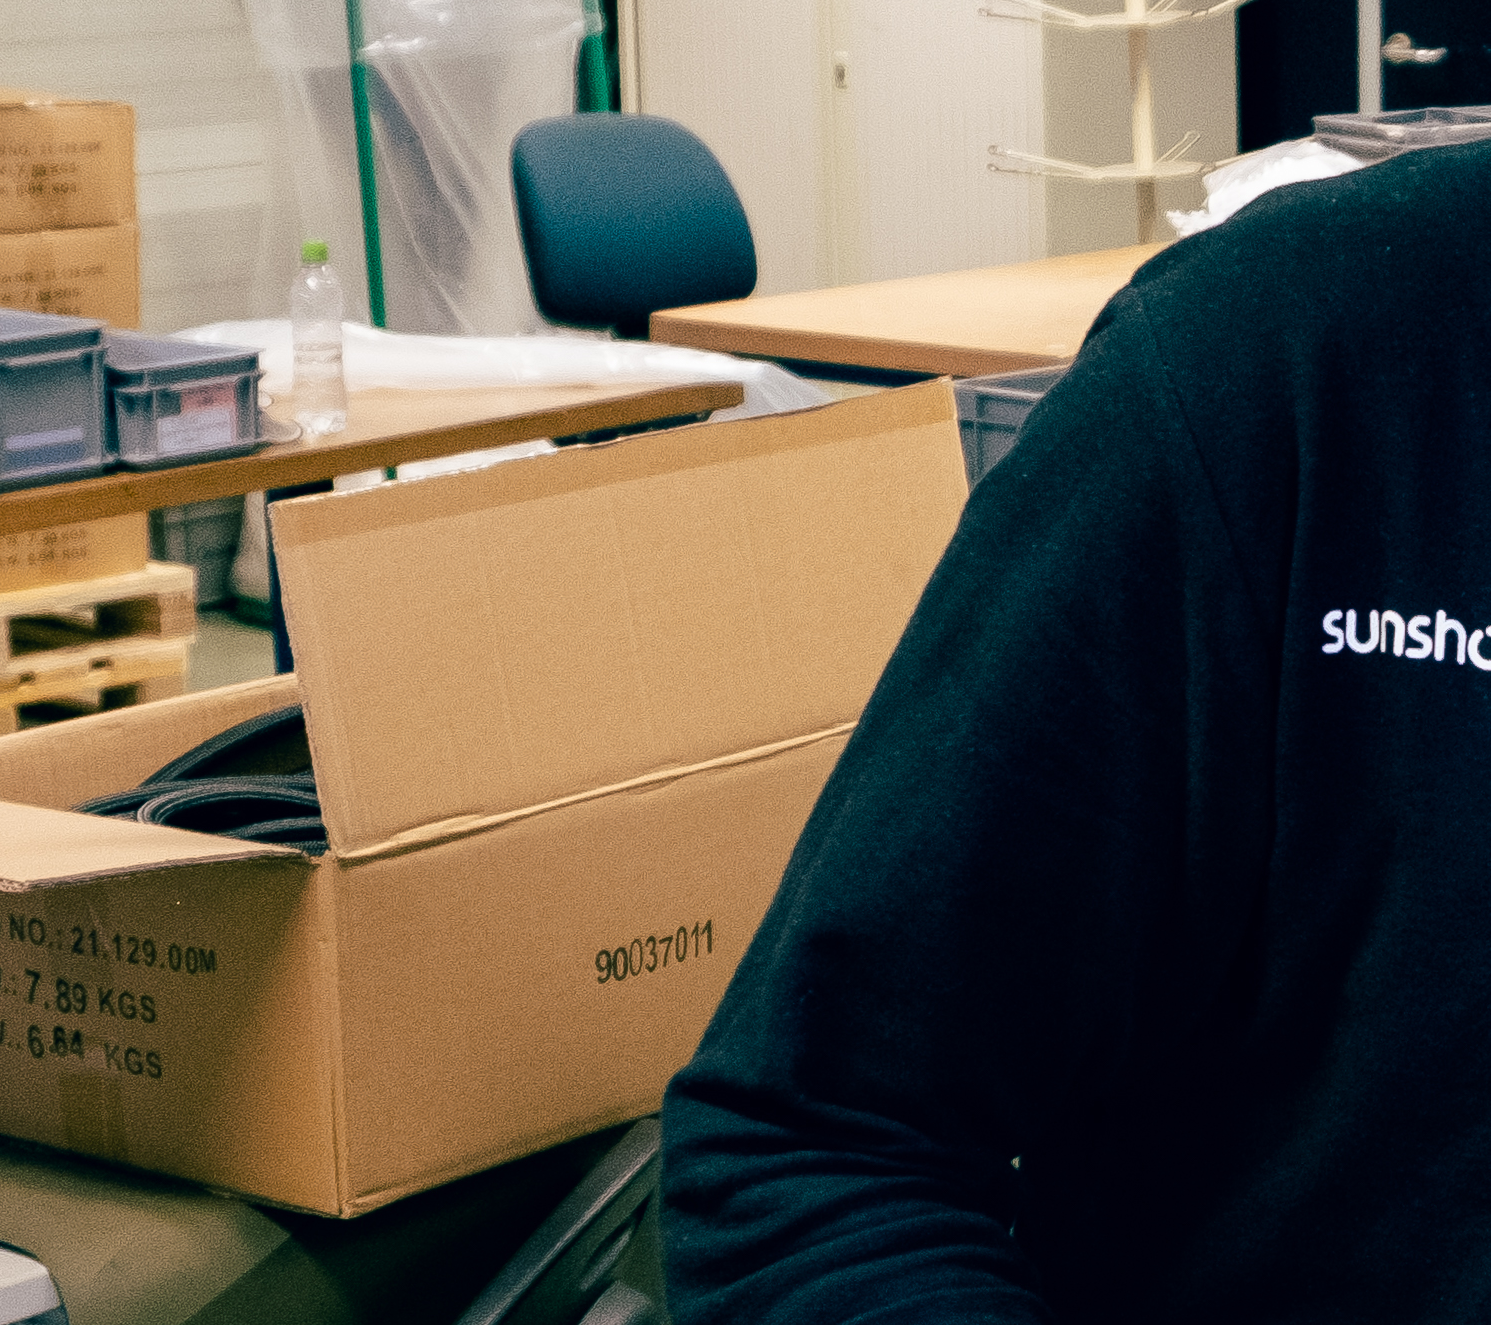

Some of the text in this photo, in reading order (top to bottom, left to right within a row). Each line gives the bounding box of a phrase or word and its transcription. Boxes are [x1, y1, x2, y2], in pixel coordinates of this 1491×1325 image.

[594, 919, 713, 985] 90037011
[25, 968, 89, 1014] 7.89
[97, 986, 158, 1024] KGS
[104, 1042, 163, 1079] KGS
